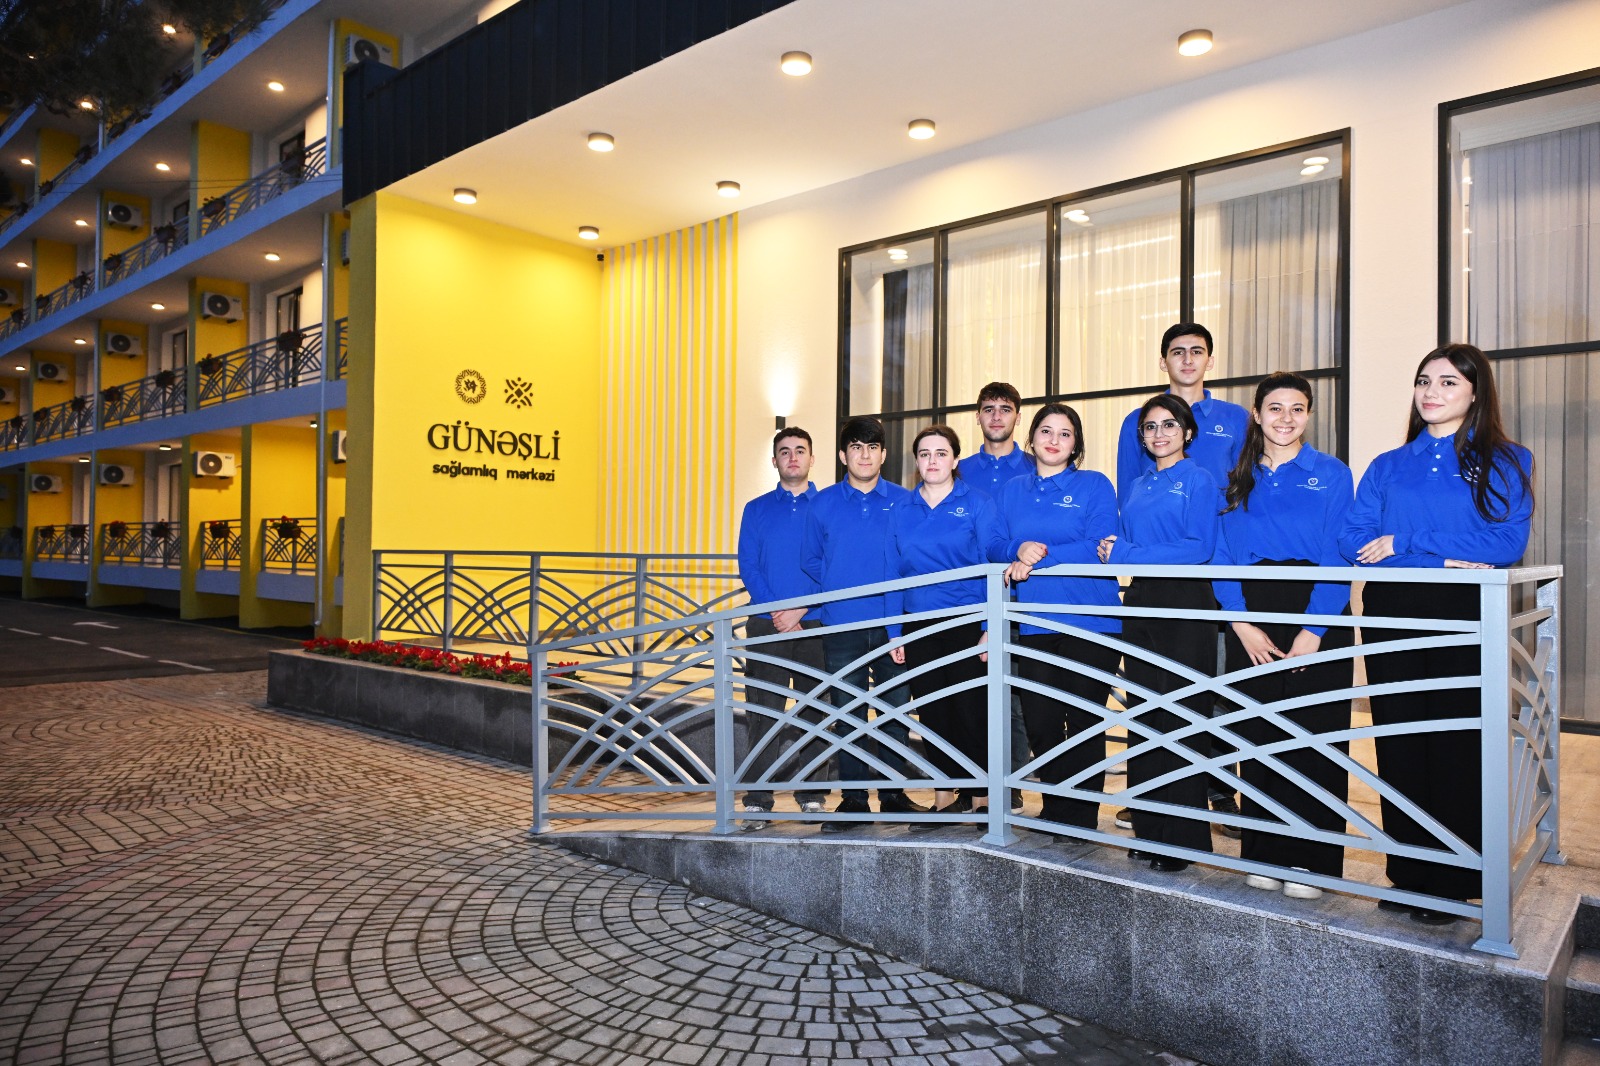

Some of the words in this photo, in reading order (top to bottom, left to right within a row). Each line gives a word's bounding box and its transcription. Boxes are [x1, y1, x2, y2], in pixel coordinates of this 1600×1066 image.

[427, 420, 560, 461] GÜNƏŞLİ
[432, 460, 498, 480] sağlamlıq
[506, 468, 555, 481] mərkəzi
